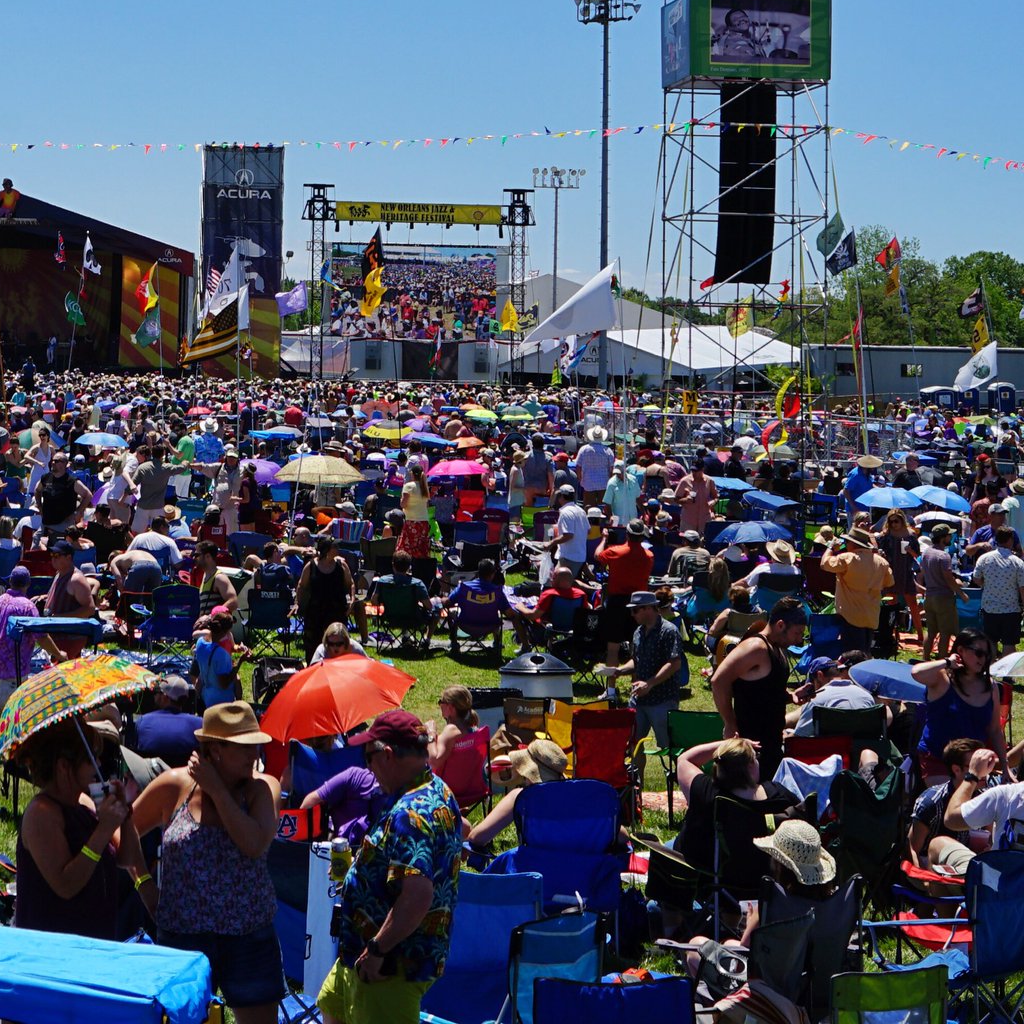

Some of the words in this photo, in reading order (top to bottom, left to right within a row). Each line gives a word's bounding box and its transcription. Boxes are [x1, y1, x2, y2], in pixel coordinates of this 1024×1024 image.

[217, 189, 272, 199] ACURA
[381, 203, 396, 212] NEW
[398, 204, 429, 213] ORLEANS
[431, 205, 448, 213] JAZZ
[381, 212, 418, 221] HERITAGE
[421, 214, 455, 222] FESTIVAL
[686, 392, 696, 402] M
[686, 404, 694, 414] 7
[466, 590, 496, 604] LSU
